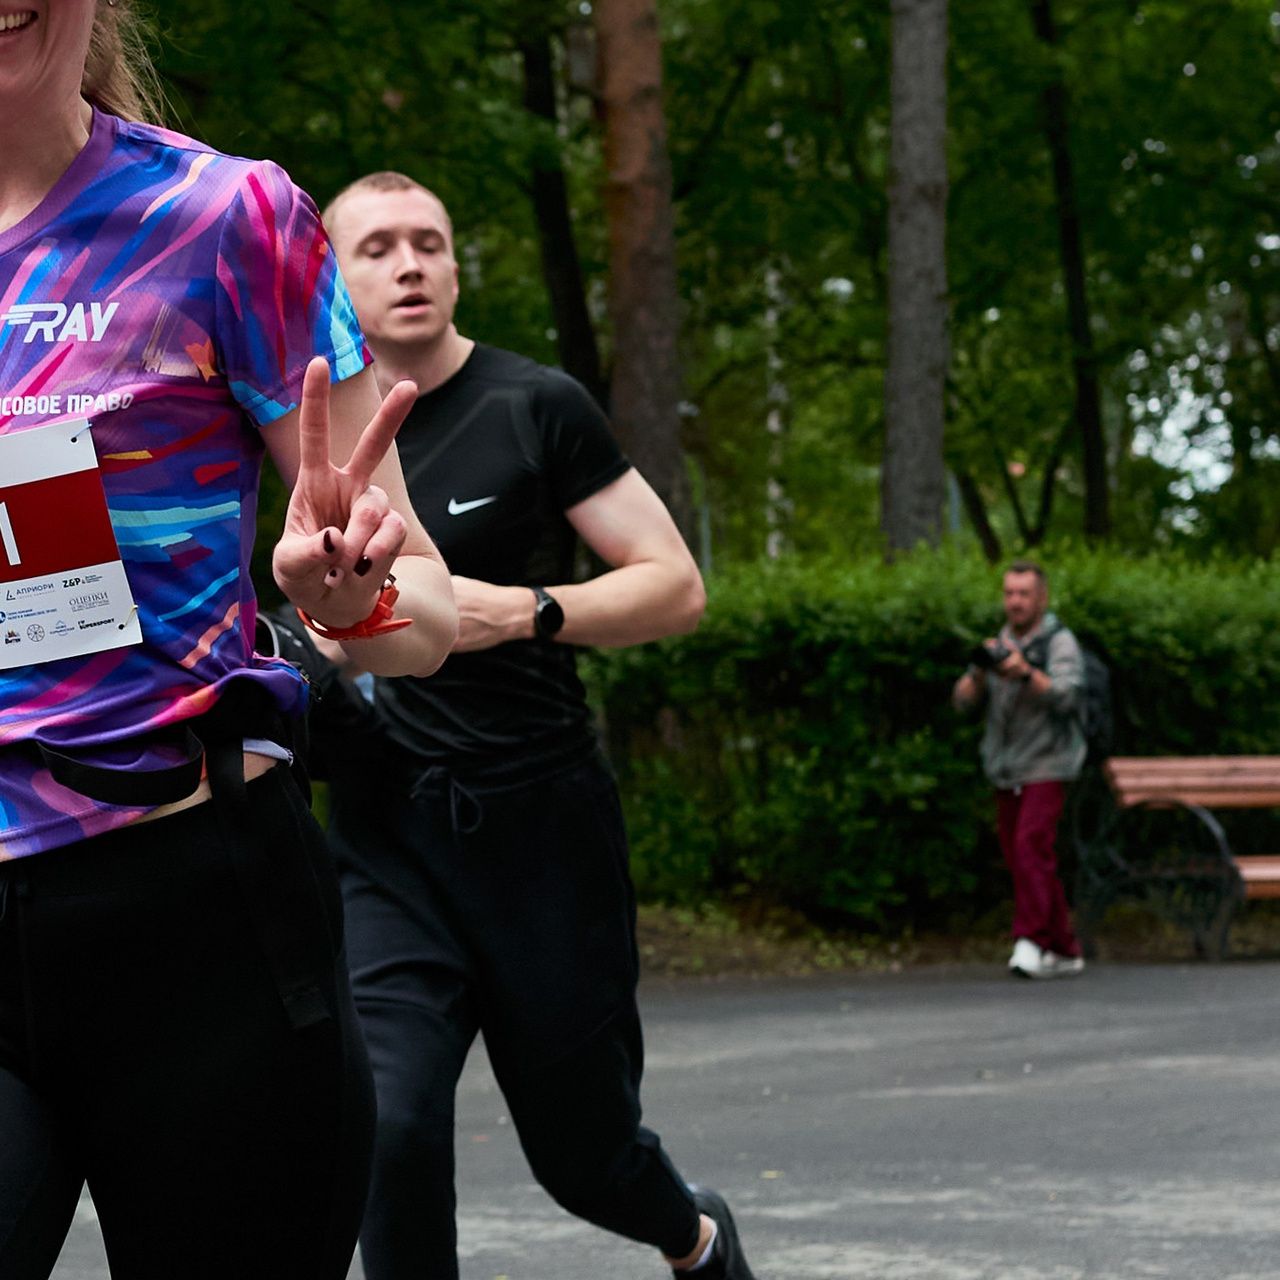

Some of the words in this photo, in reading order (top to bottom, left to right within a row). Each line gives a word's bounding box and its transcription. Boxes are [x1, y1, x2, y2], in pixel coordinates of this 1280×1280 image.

[66, 392, 135, 414] ПРАВО
[16, 583, 55, 595] АПРИОРИ
[62, 577, 81, 589] Z&P
